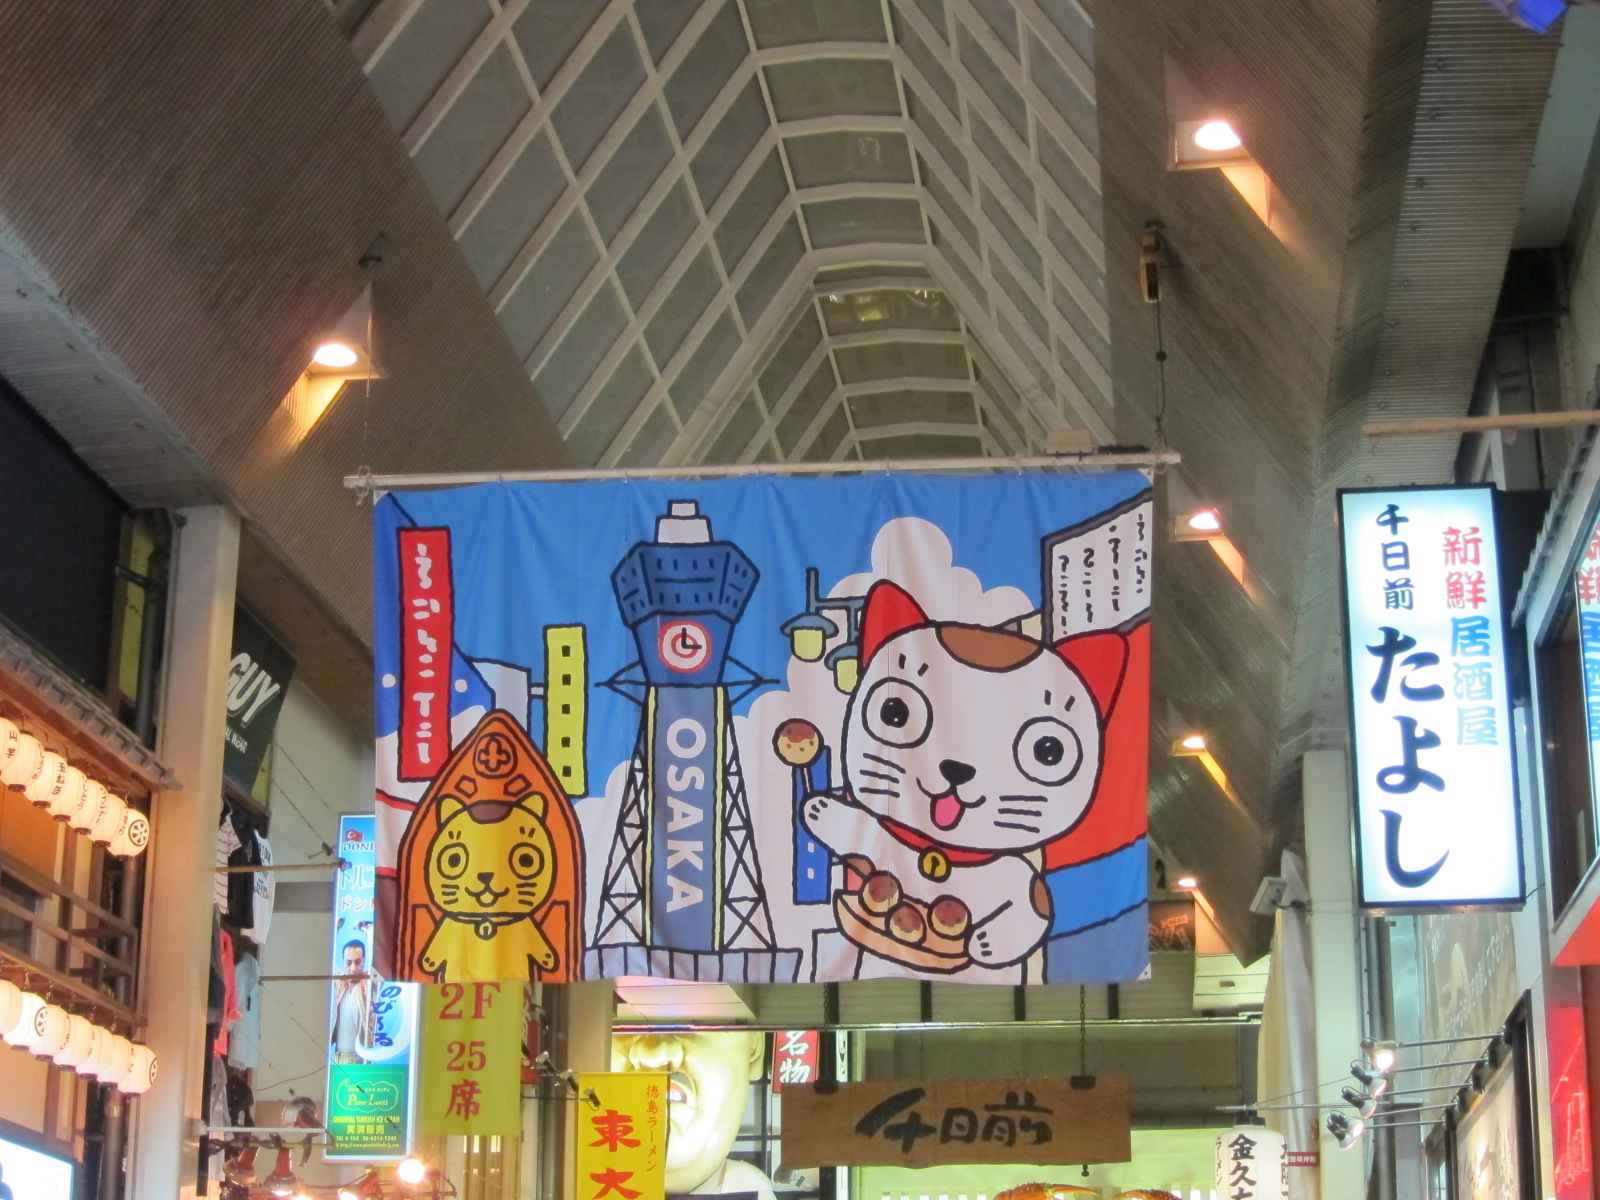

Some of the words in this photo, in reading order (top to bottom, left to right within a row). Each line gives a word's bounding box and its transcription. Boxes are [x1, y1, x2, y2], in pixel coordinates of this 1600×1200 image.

[1376, 504, 1415, 611] 千日前
[227, 652, 281, 727] GUY
[1366, 626, 1450, 889] たよし
[666, 718, 707, 913] OSAKA
[438, 982, 501, 1020] 2F
[446, 1041, 487, 1072] 25
[778, 1030, 811, 1083] 名物
[444, 1079, 482, 1122] 席
[646, 1084, 660, 1172] 徳島ラーメン
[855, 1087, 1055, 1155] 千日前
[588, 1109, 644, 1200] 東大
